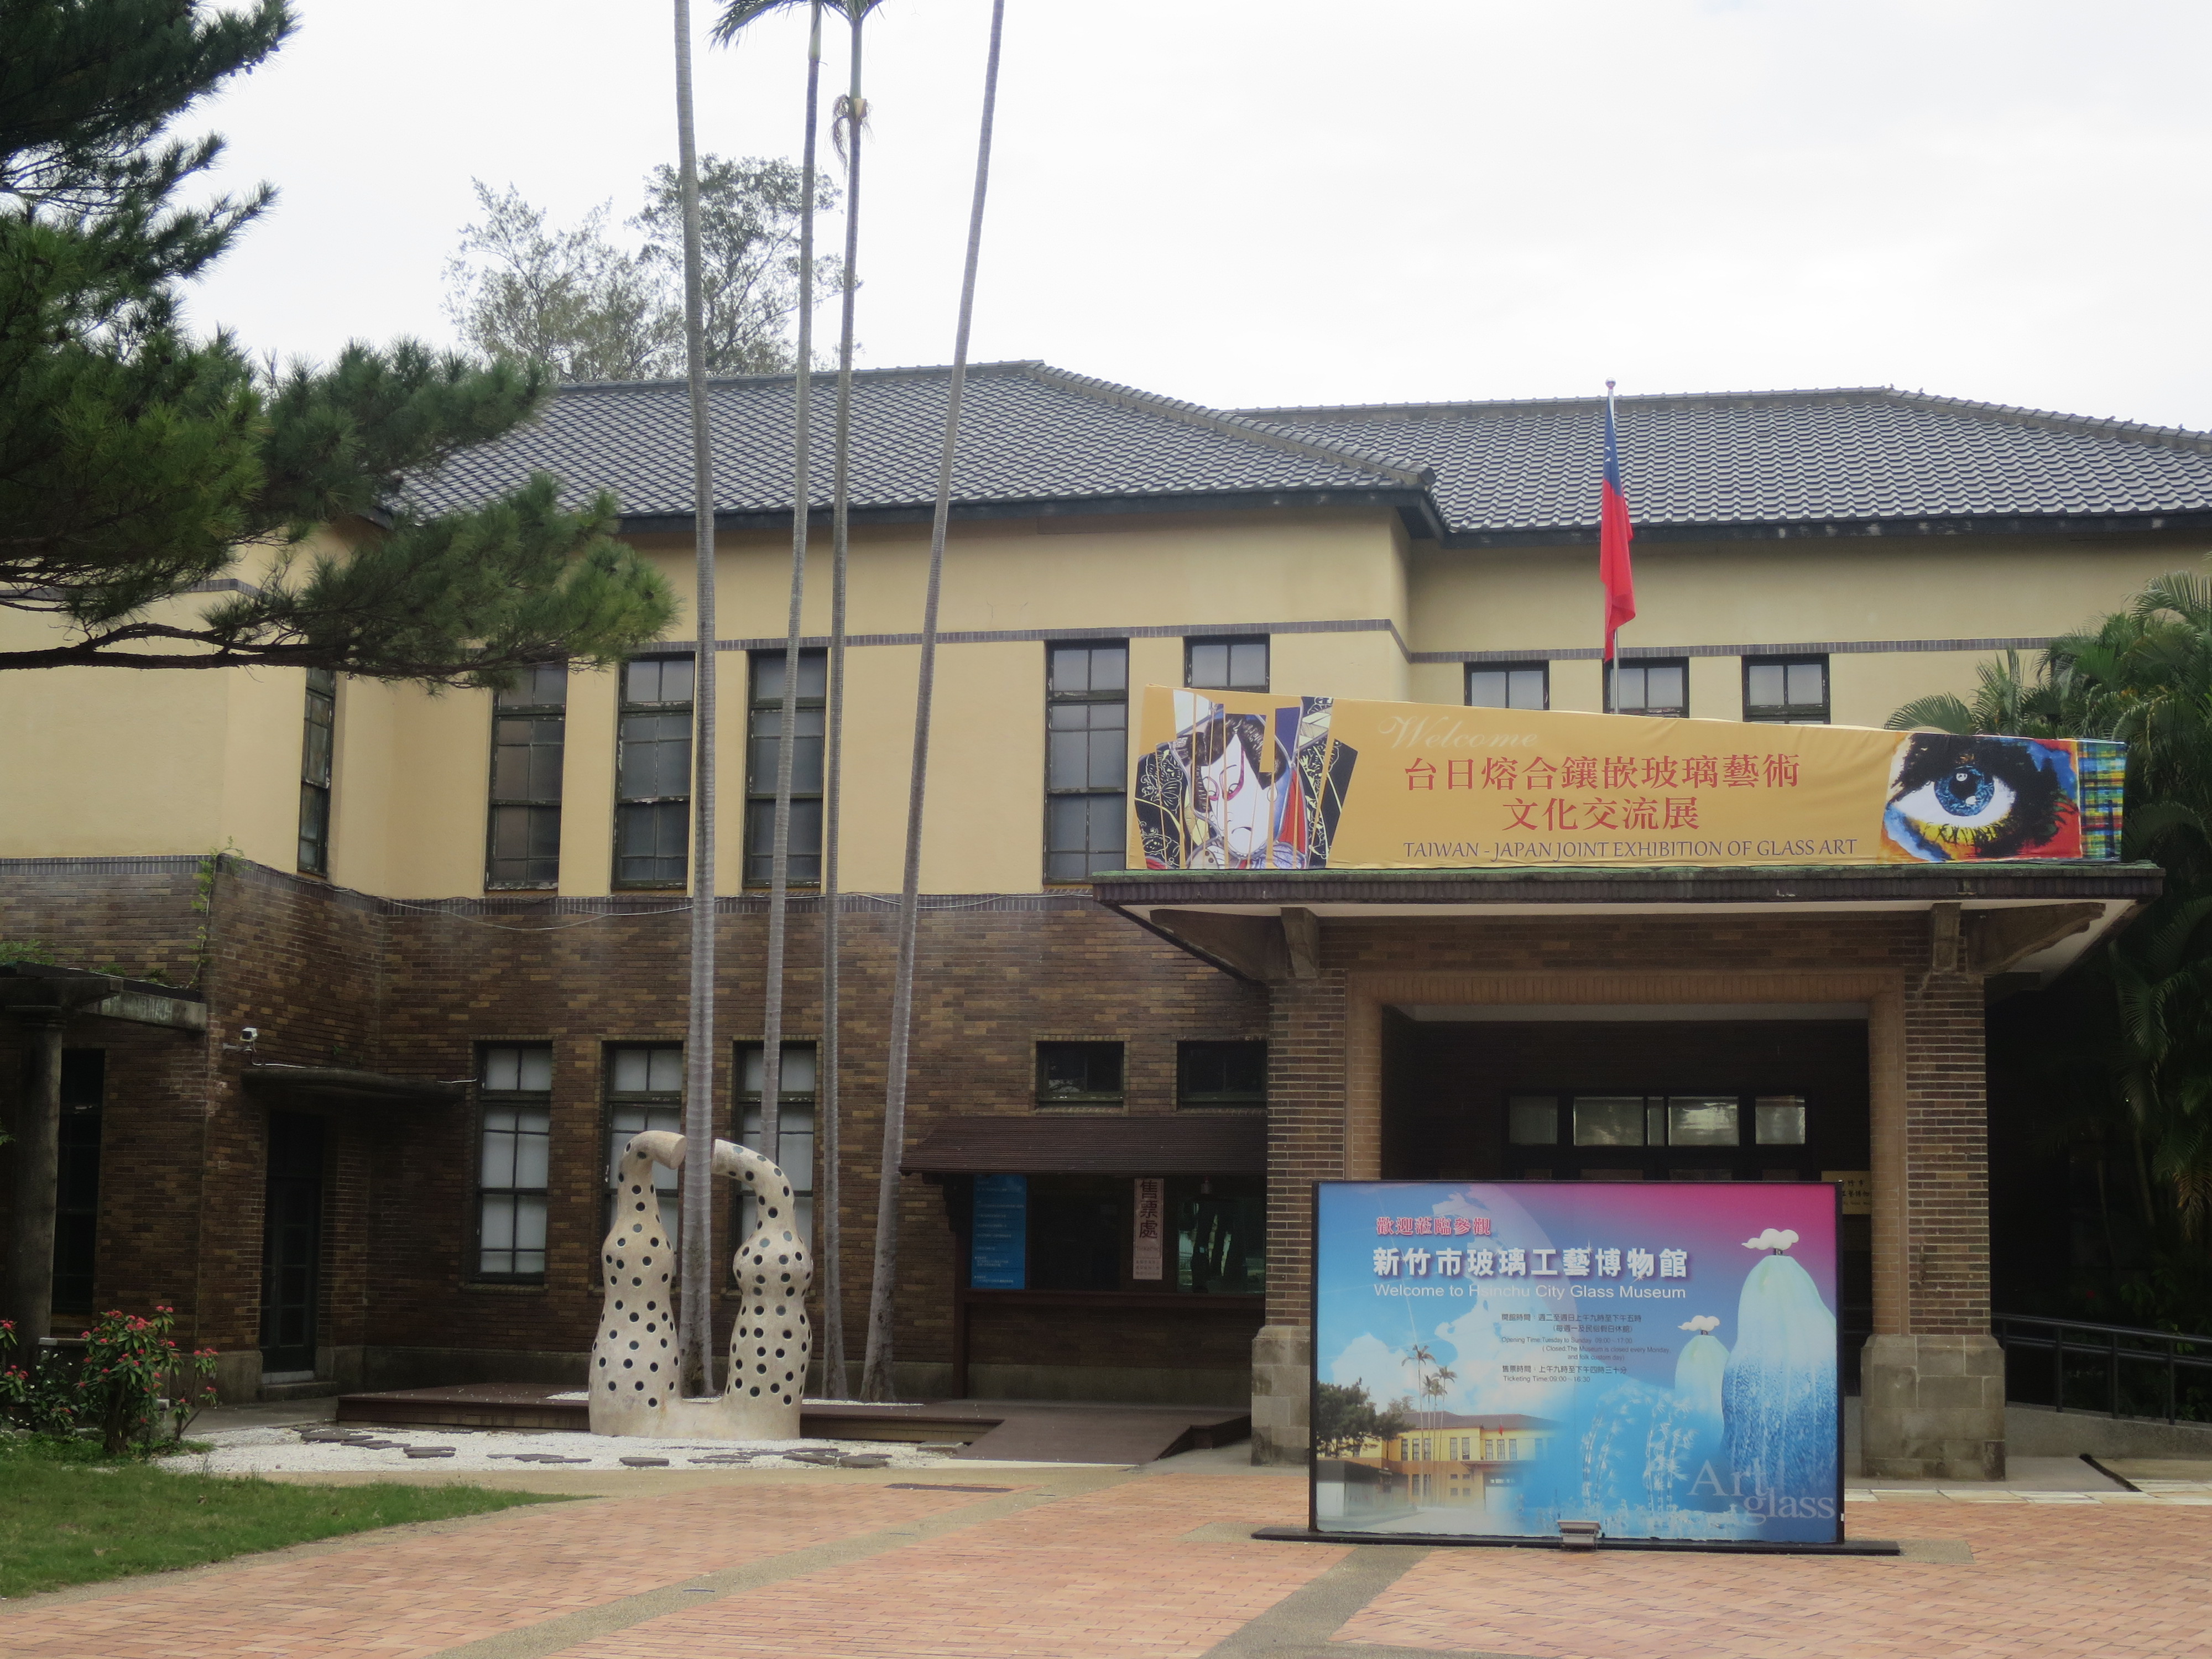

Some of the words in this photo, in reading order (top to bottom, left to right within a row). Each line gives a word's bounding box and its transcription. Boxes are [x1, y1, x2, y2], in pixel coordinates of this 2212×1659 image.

[1378, 716, 1538, 749] Welcome
[1405, 754, 1799, 791] 台日熔合鑲嵌玻璃藝術
[1502, 796, 1699, 831] 文化交流展
[1403, 842, 1479, 857] TAIWAN
[1491, 842, 1552, 862] JAPAN
[1553, 842, 1609, 862] JOINT
[1614, 841, 1723, 857] EXHIBITION
[1728, 841, 1752, 857] OF
[1757, 840, 1814, 856] GLASS
[1819, 838, 1858, 855] ART
[1139, 1180, 1158, 1239] 售票處
[1376, 1217, 1491, 1235] 歡迎蒞臨參觀
[1373, 1247, 1687, 1277] 新竹市玻璃工藝博物館
[1374, 1284, 1444, 1297] Welcome
[1449, 1285, 1464, 1297] to
[1469, 1285, 1530, 1297] Hsinchu
[1535, 1285, 1566, 1300] City
[1570, 1285, 1614, 1298] Glass
[1619, 1285, 1686, 1298] Museum
[1686, 1458, 1770, 1496] Art
[1743, 1486, 1836, 1526] glass
